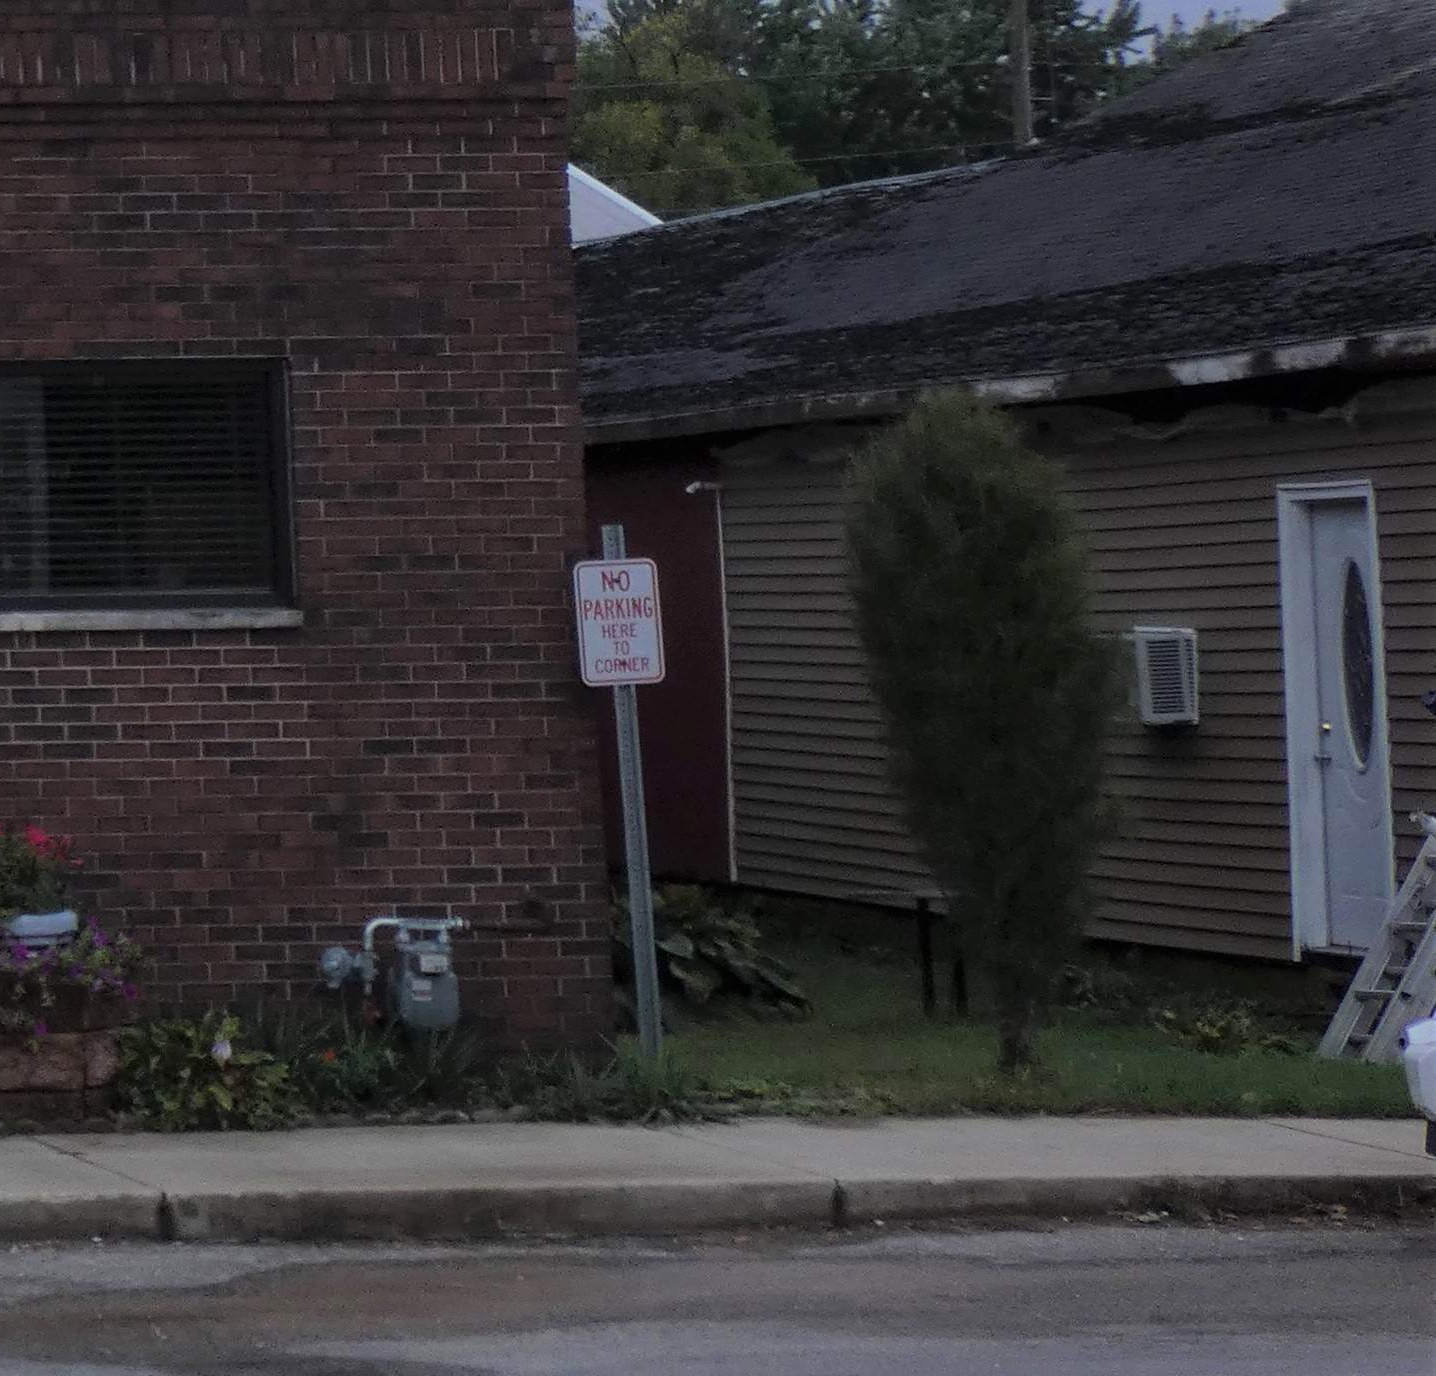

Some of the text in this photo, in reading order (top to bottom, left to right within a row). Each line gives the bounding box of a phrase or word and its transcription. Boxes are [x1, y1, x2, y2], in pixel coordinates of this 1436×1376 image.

[601, 570, 631, 592] NO
[583, 597, 653, 621] PARKING
[601, 622, 638, 639] HERE
[613, 641, 630, 656] TO
[595, 657, 650, 673] CORNER
